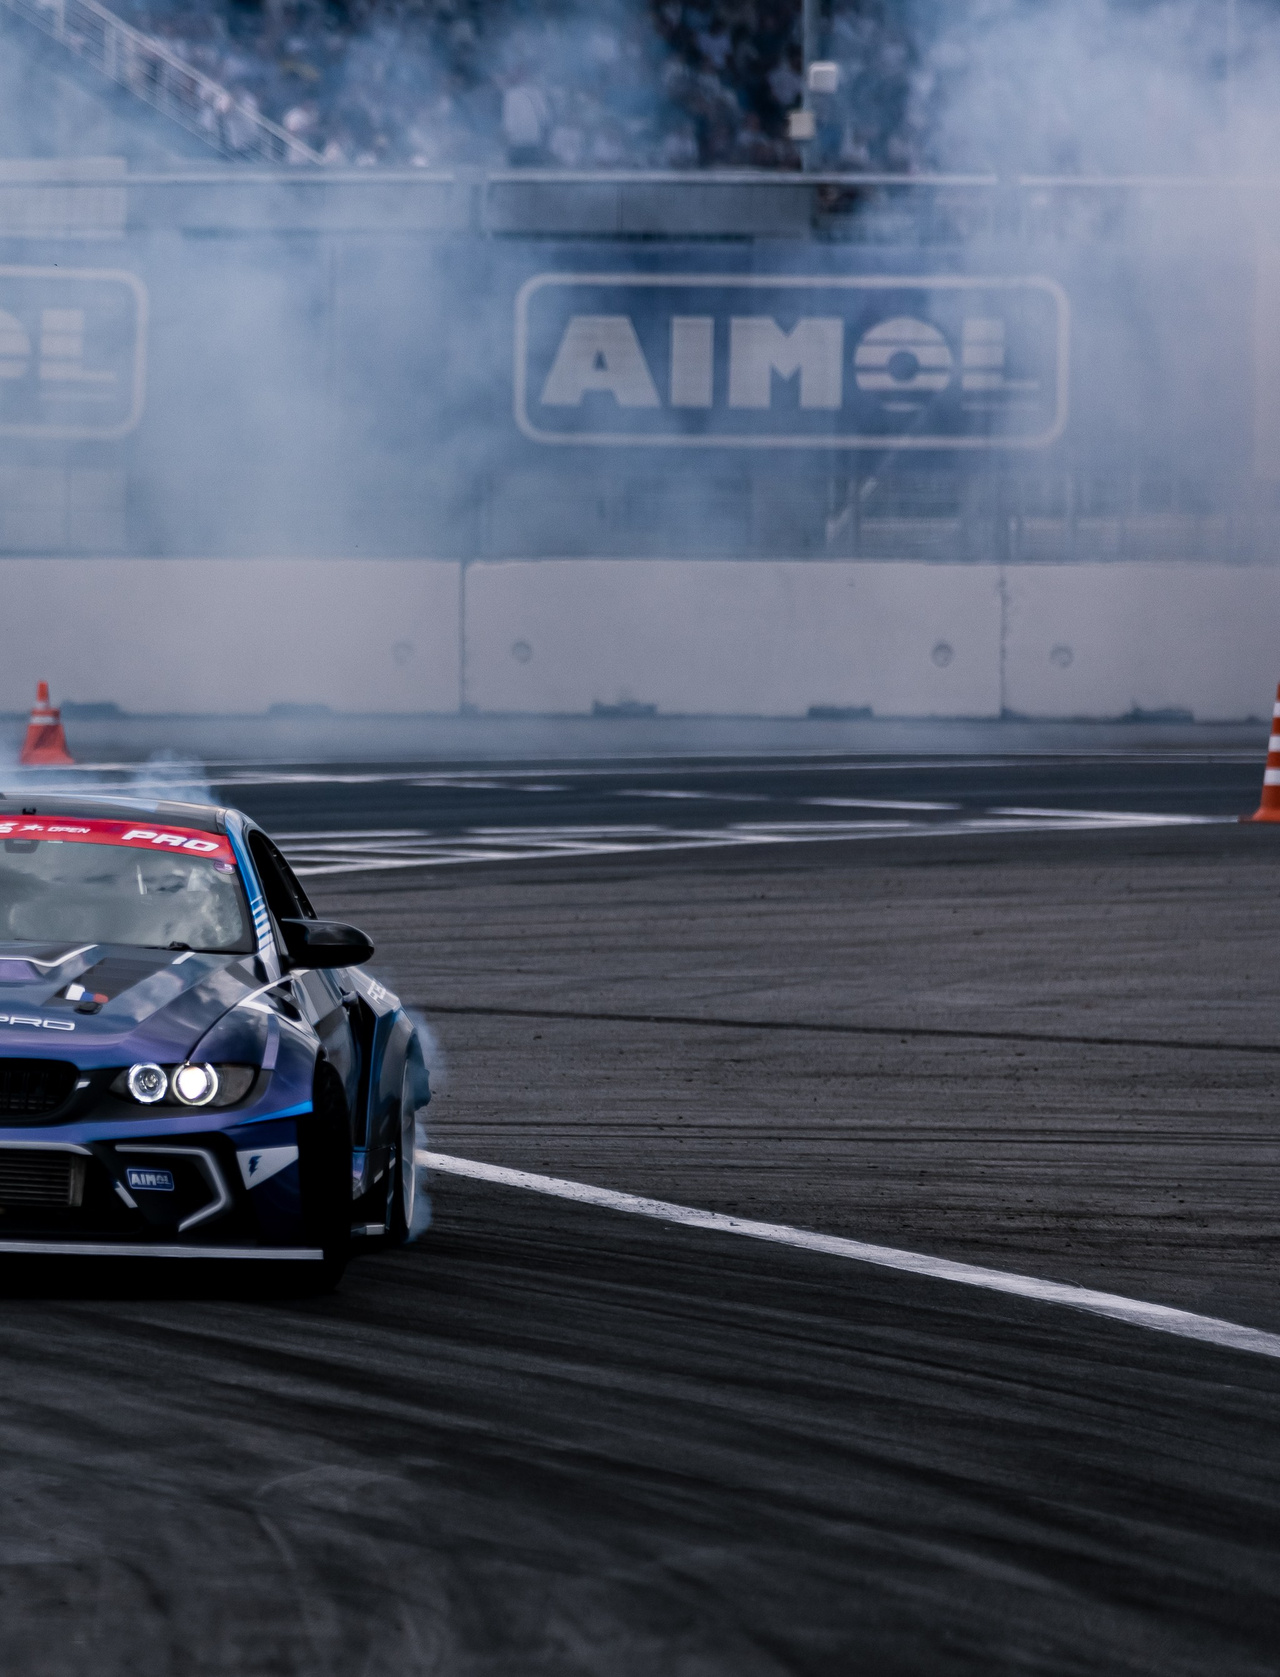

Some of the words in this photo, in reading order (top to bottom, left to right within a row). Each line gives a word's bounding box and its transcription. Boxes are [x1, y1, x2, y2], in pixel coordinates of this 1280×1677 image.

[540, 315, 1039, 410] AIMOL
[47, 825, 91, 834] OPEN
[121, 829, 219, 852] PRO
